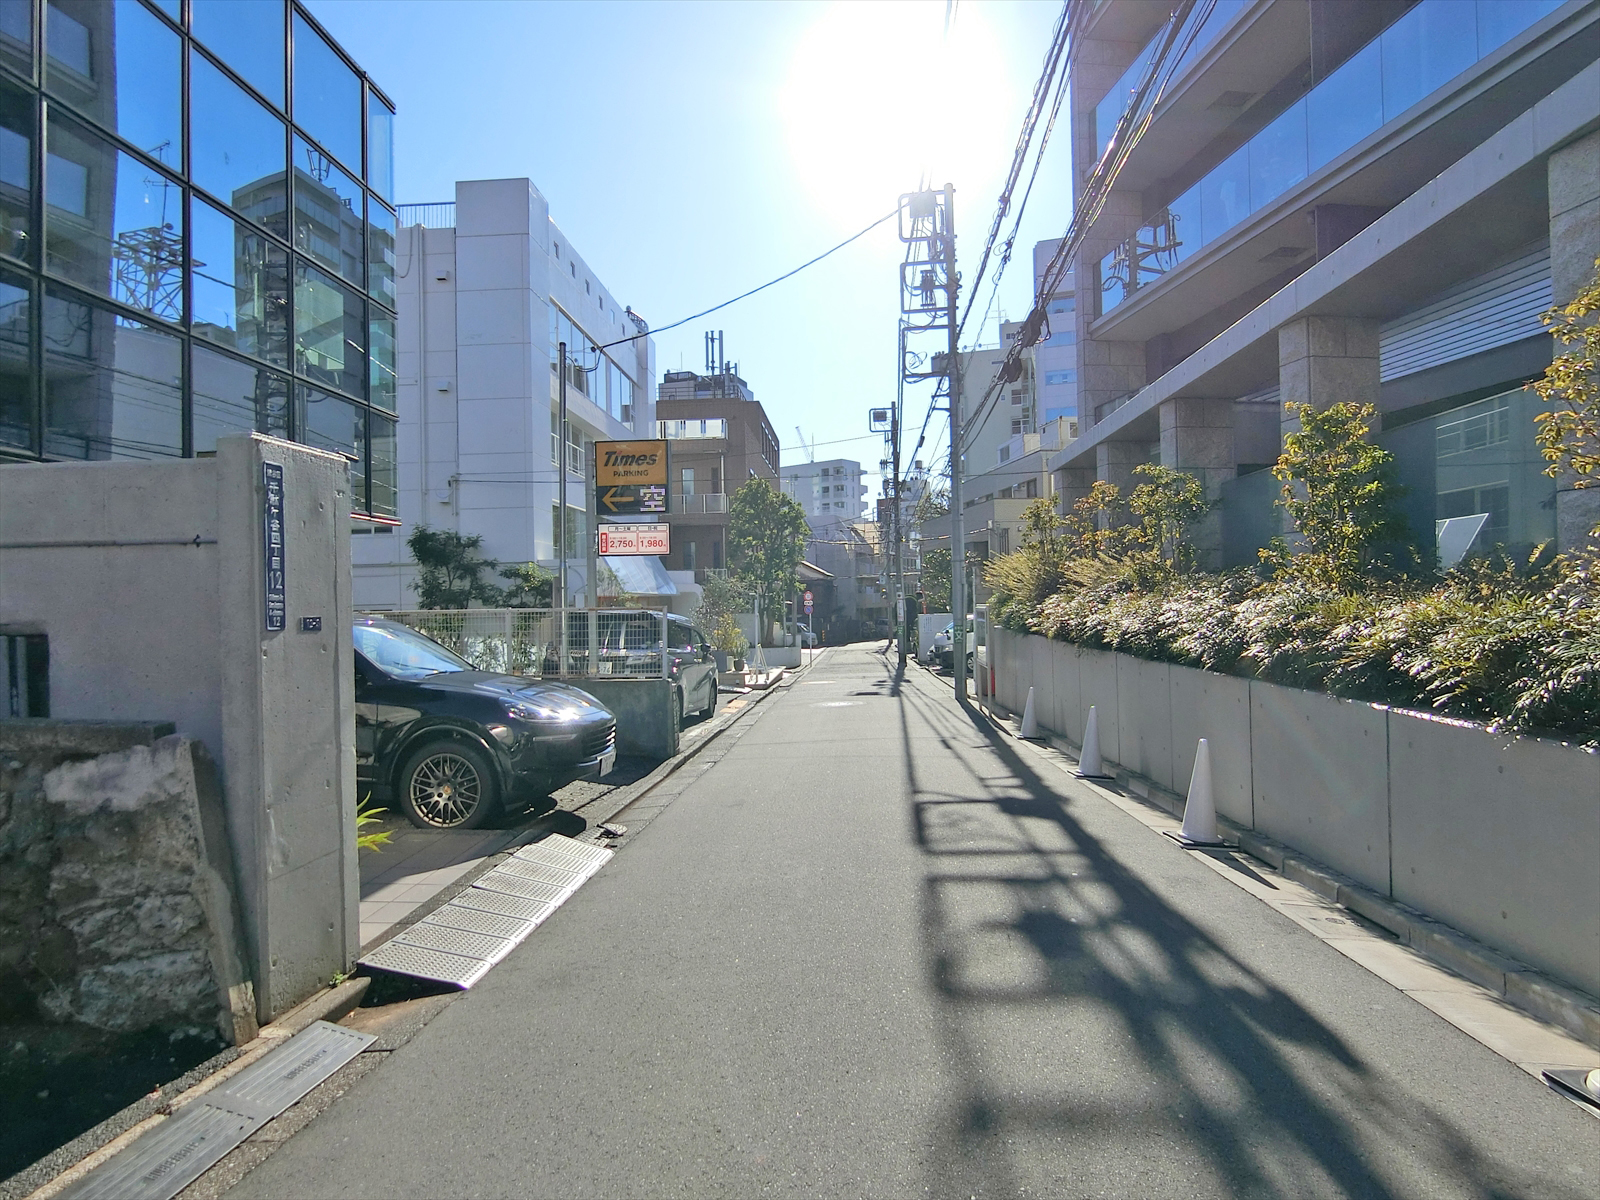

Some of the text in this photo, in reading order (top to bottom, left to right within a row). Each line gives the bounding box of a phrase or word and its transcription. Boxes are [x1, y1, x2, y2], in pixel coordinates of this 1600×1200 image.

[604, 451, 657, 467] Times
[640, 486, 665, 511] 空
[269, 571, 283, 589] 12
[274, 617, 281, 626] 12
